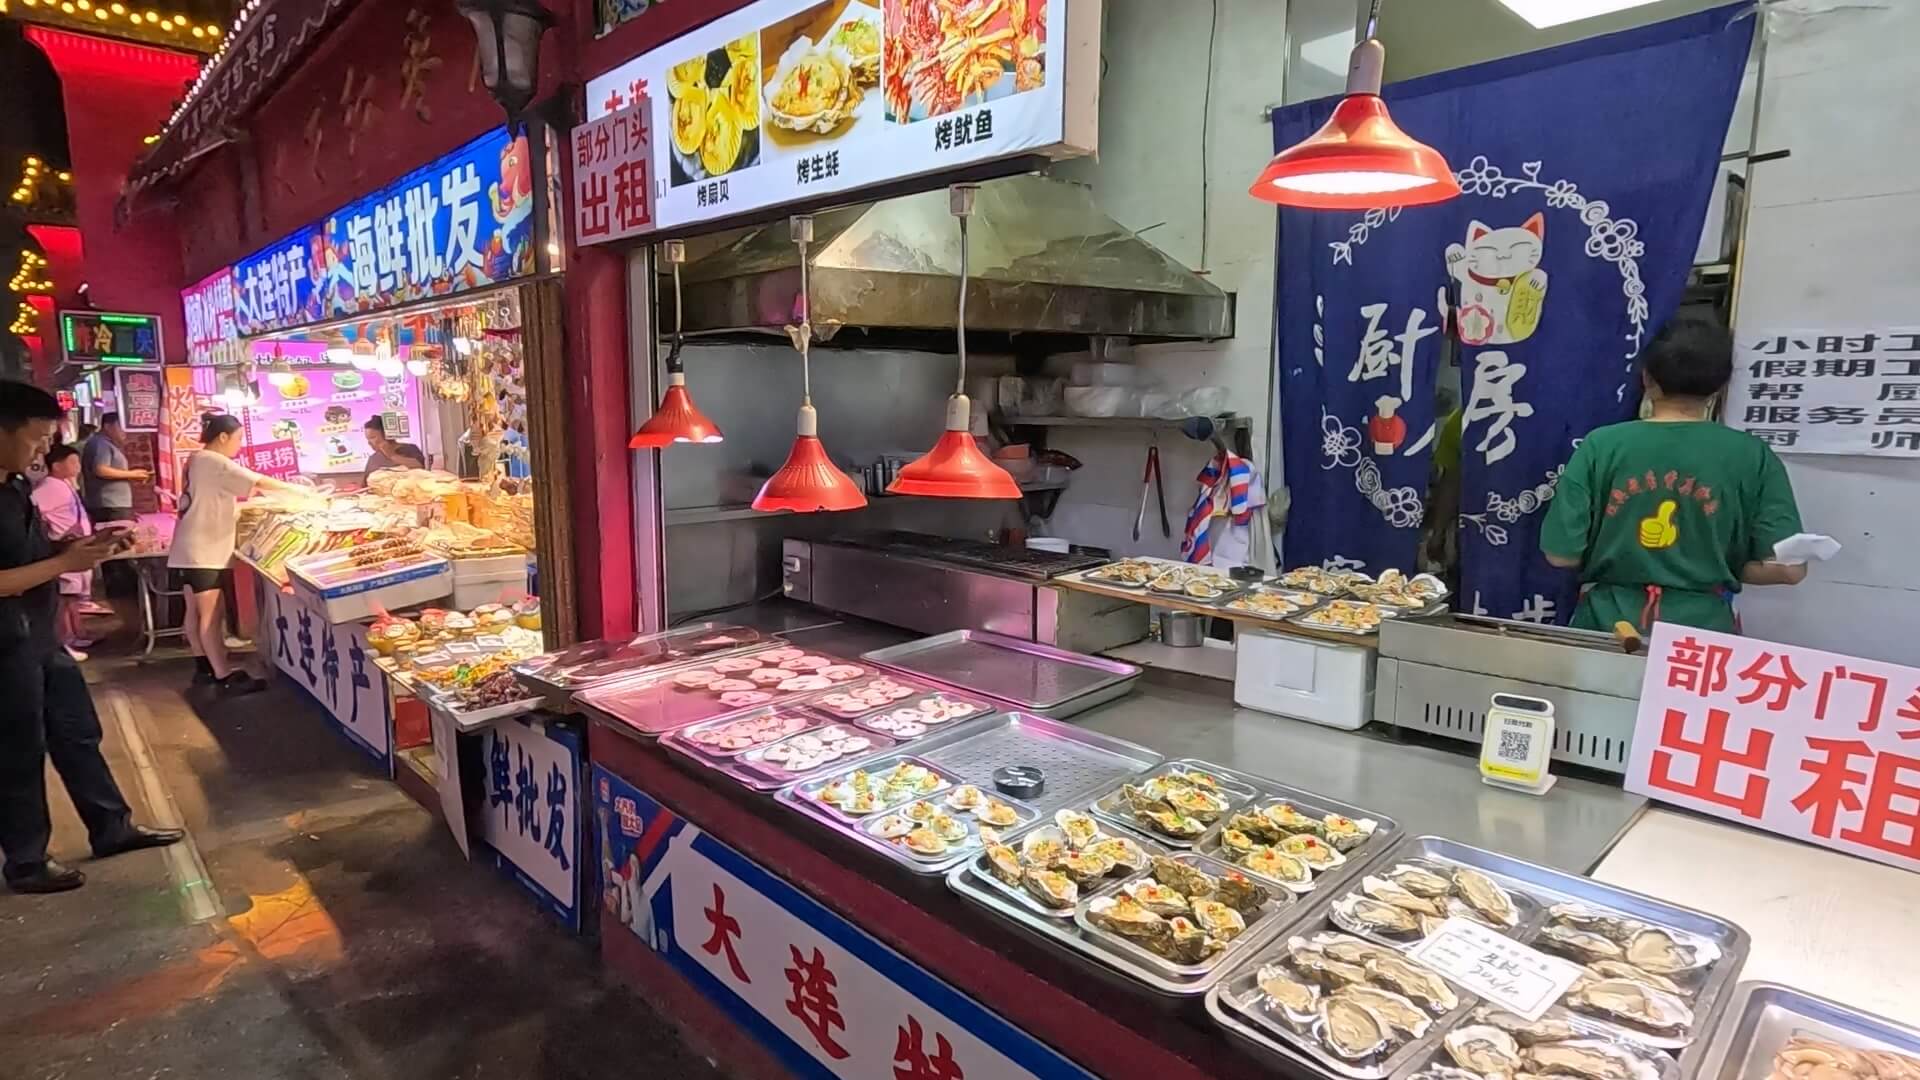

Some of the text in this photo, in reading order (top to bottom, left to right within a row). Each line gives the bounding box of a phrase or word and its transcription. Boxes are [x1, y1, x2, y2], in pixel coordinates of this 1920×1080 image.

[577, 108, 648, 169] 部分门头
[935, 109, 993, 152] 烤鱿鱼
[582, 158, 650, 238] 出租
[697, 179, 729, 208] 烤扇贝
[797, 150, 839, 185] 烤生蚝
[346, 163, 483, 299] 海鲜批发
[244, 244, 306, 323] 大连特产
[1748, 359, 1920, 379] 假期工
[1751, 333, 1920, 355] 小时工
[1348, 303, 1535, 465] 厨房
[1743, 405, 1920, 426] 服务员
[275, 593, 371, 724] 大连特产
[489, 727, 571, 872] 鲜批发
[1648, 708, 1920, 862] 出租
